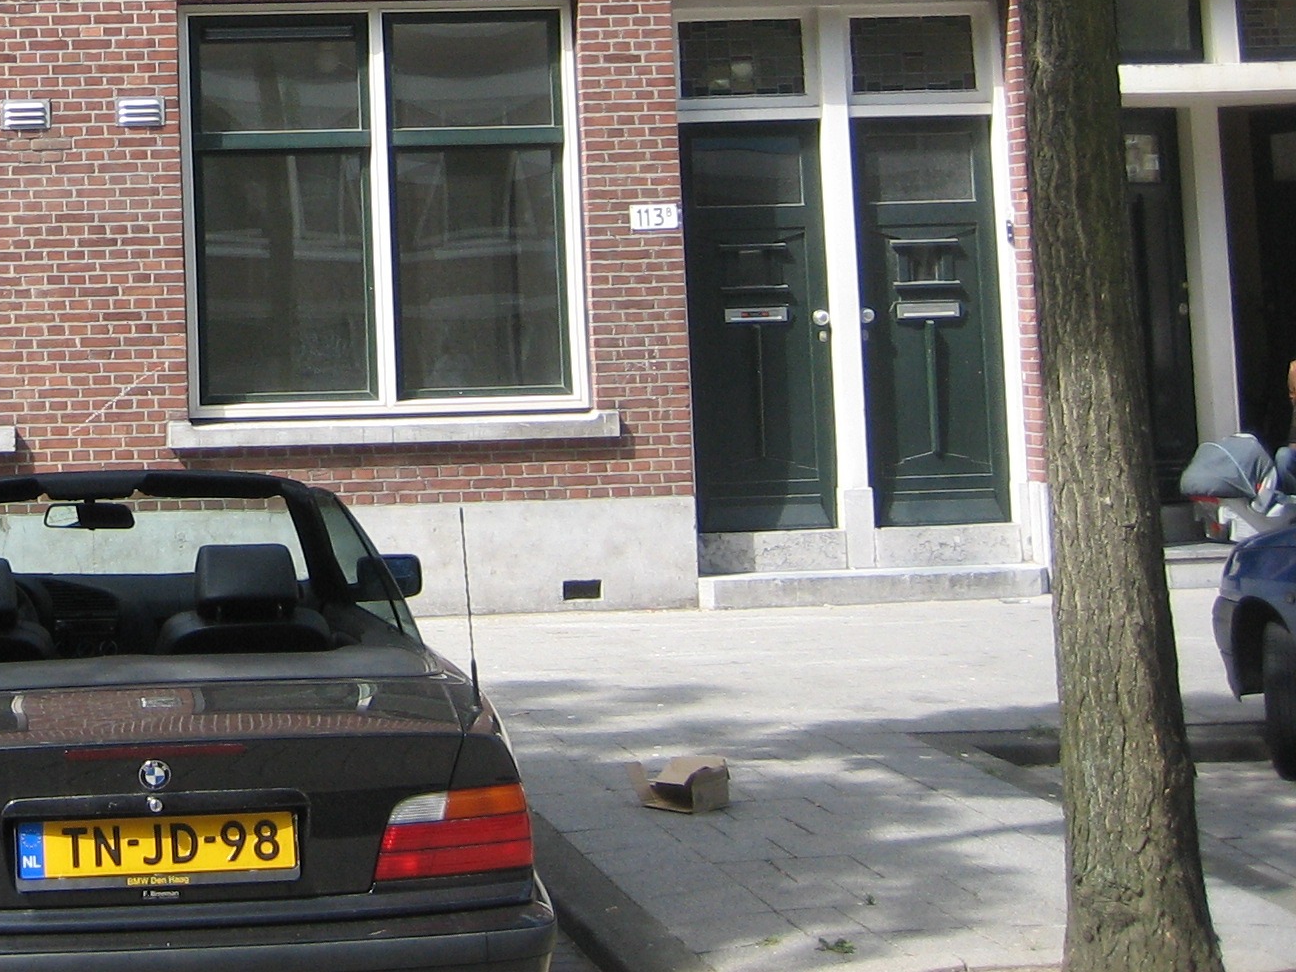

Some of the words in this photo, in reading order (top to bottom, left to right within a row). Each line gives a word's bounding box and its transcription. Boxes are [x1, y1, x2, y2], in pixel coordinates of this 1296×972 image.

[61, 818, 281, 869] TN-JD-98
[22, 855, 42, 869] NL
[127, 877, 149, 886] BMW
[150, 876, 167, 885] Den
